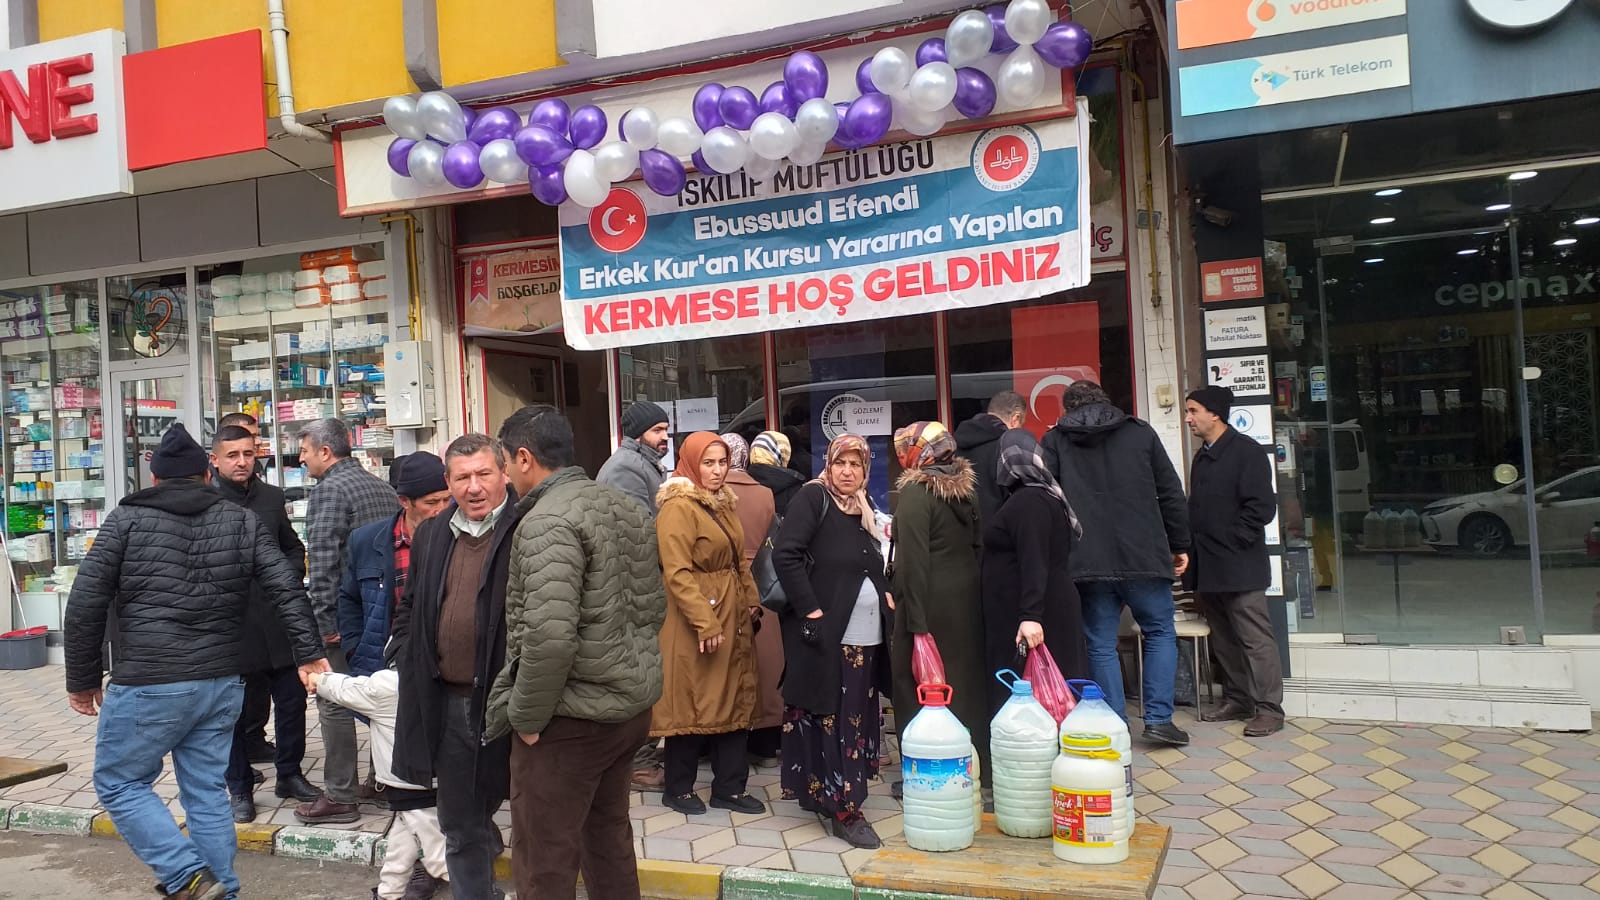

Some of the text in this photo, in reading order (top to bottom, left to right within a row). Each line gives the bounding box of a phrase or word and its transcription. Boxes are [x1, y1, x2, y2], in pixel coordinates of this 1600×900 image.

[1293, 59, 1392, 82] Türk Telekom
[694, 184, 919, 240] Ebussuud Efendi
[580, 205, 1063, 290] Erkek Kur'an Kursu Yararına Yapılan
[584, 243, 1061, 335] KERMESE HOŞ GELDİNİZ
[1434, 272, 1596, 308] cepmax
[1209, 335, 1235, 343] Tahsilat
[1221, 326, 1249, 334] FATURA
[1233, 375, 1266, 383] GARANTİLİ
